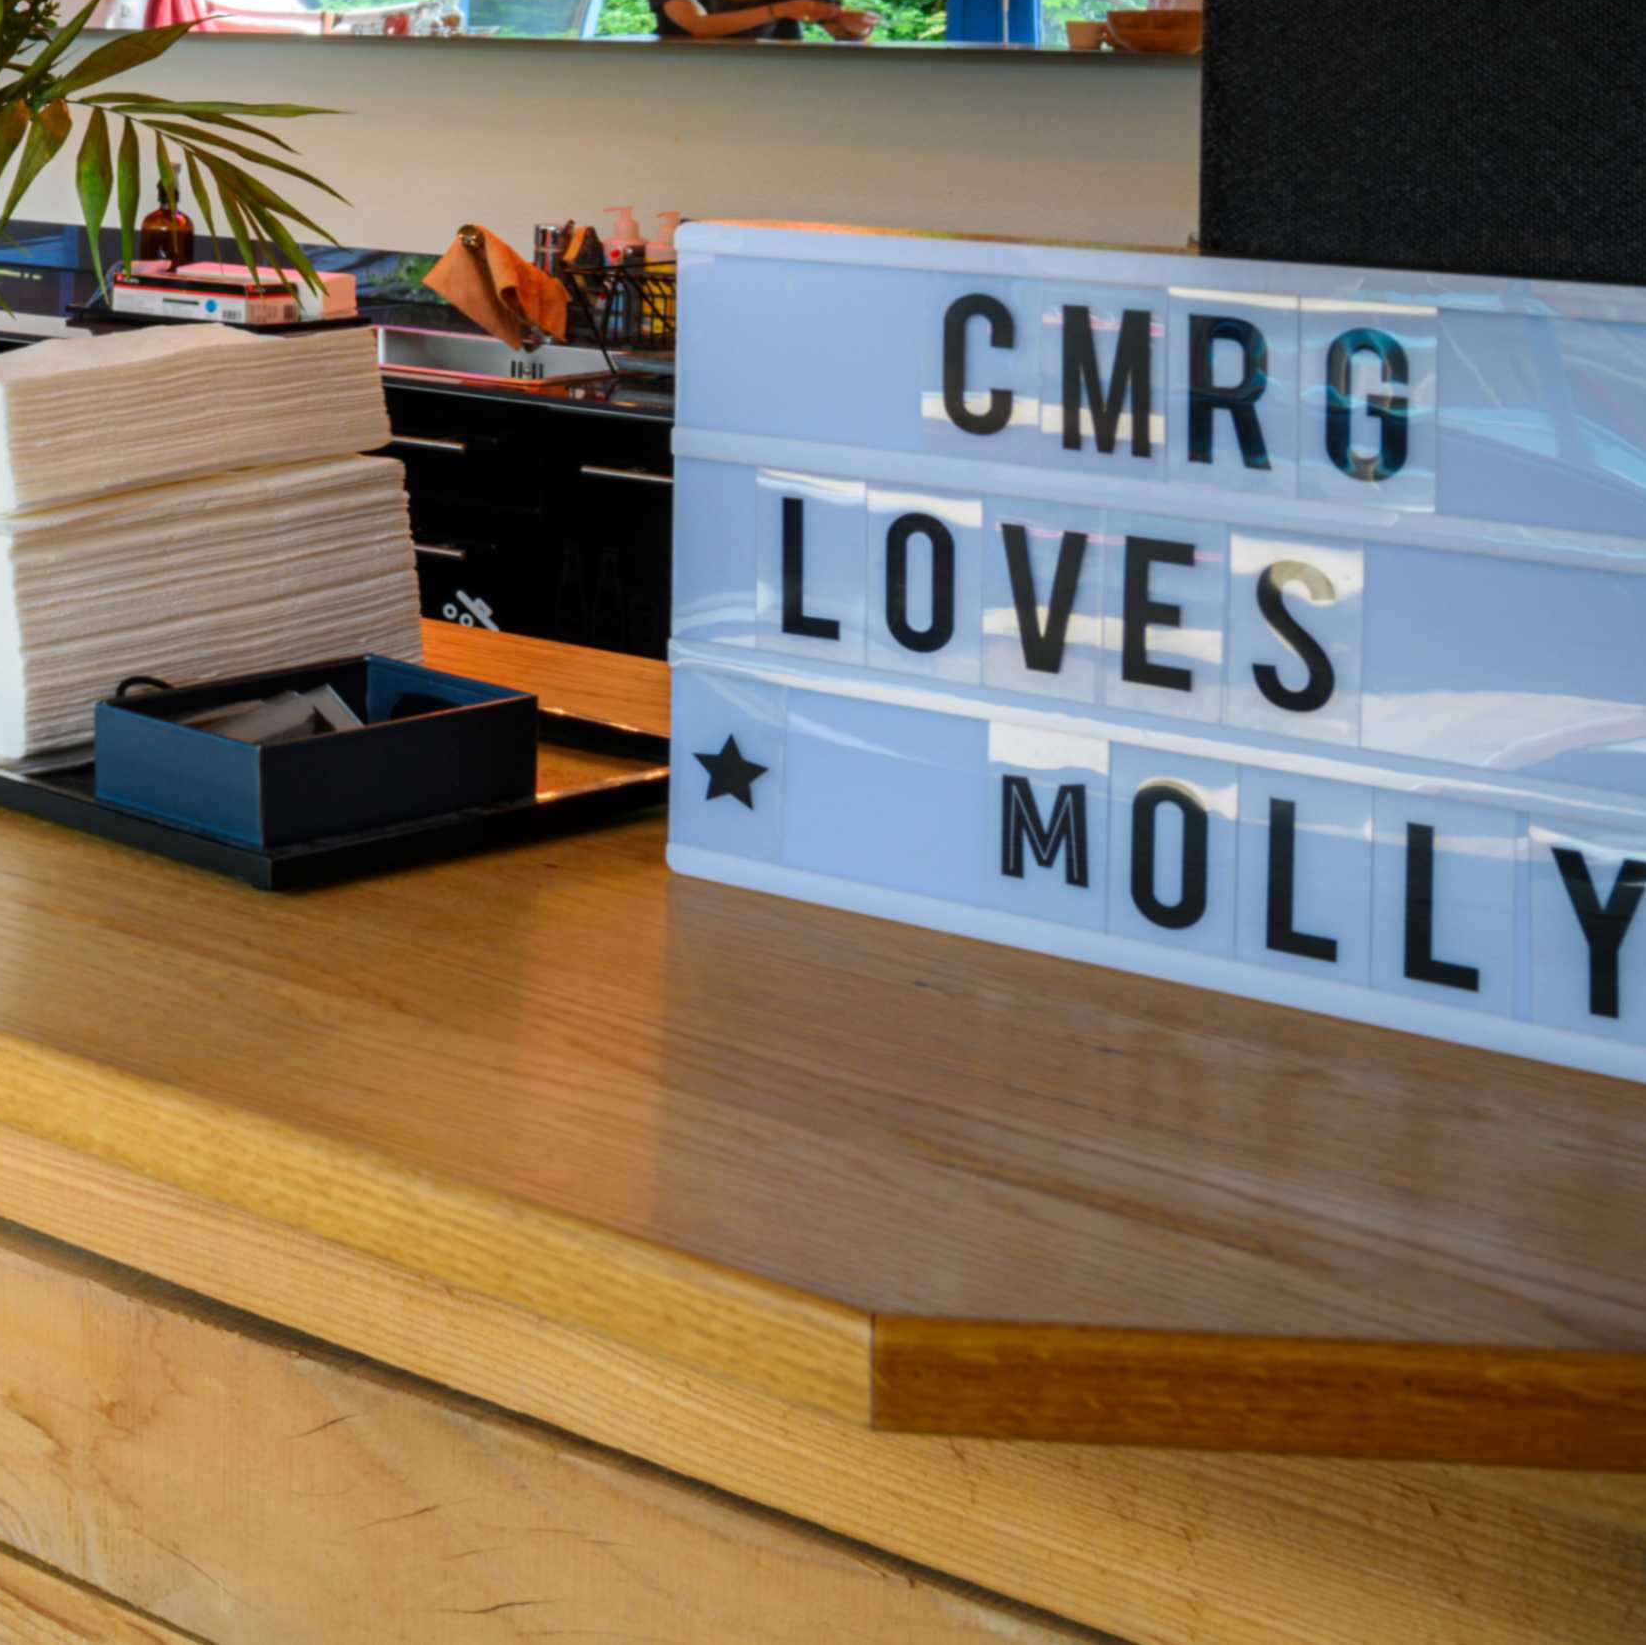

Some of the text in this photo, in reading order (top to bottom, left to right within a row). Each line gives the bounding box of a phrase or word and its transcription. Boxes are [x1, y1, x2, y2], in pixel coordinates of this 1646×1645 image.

[941, 292, 1411, 483] CMRG
[780, 496, 1336, 714] LOVES
[1000, 775, 1646, 1019] MOLLY
